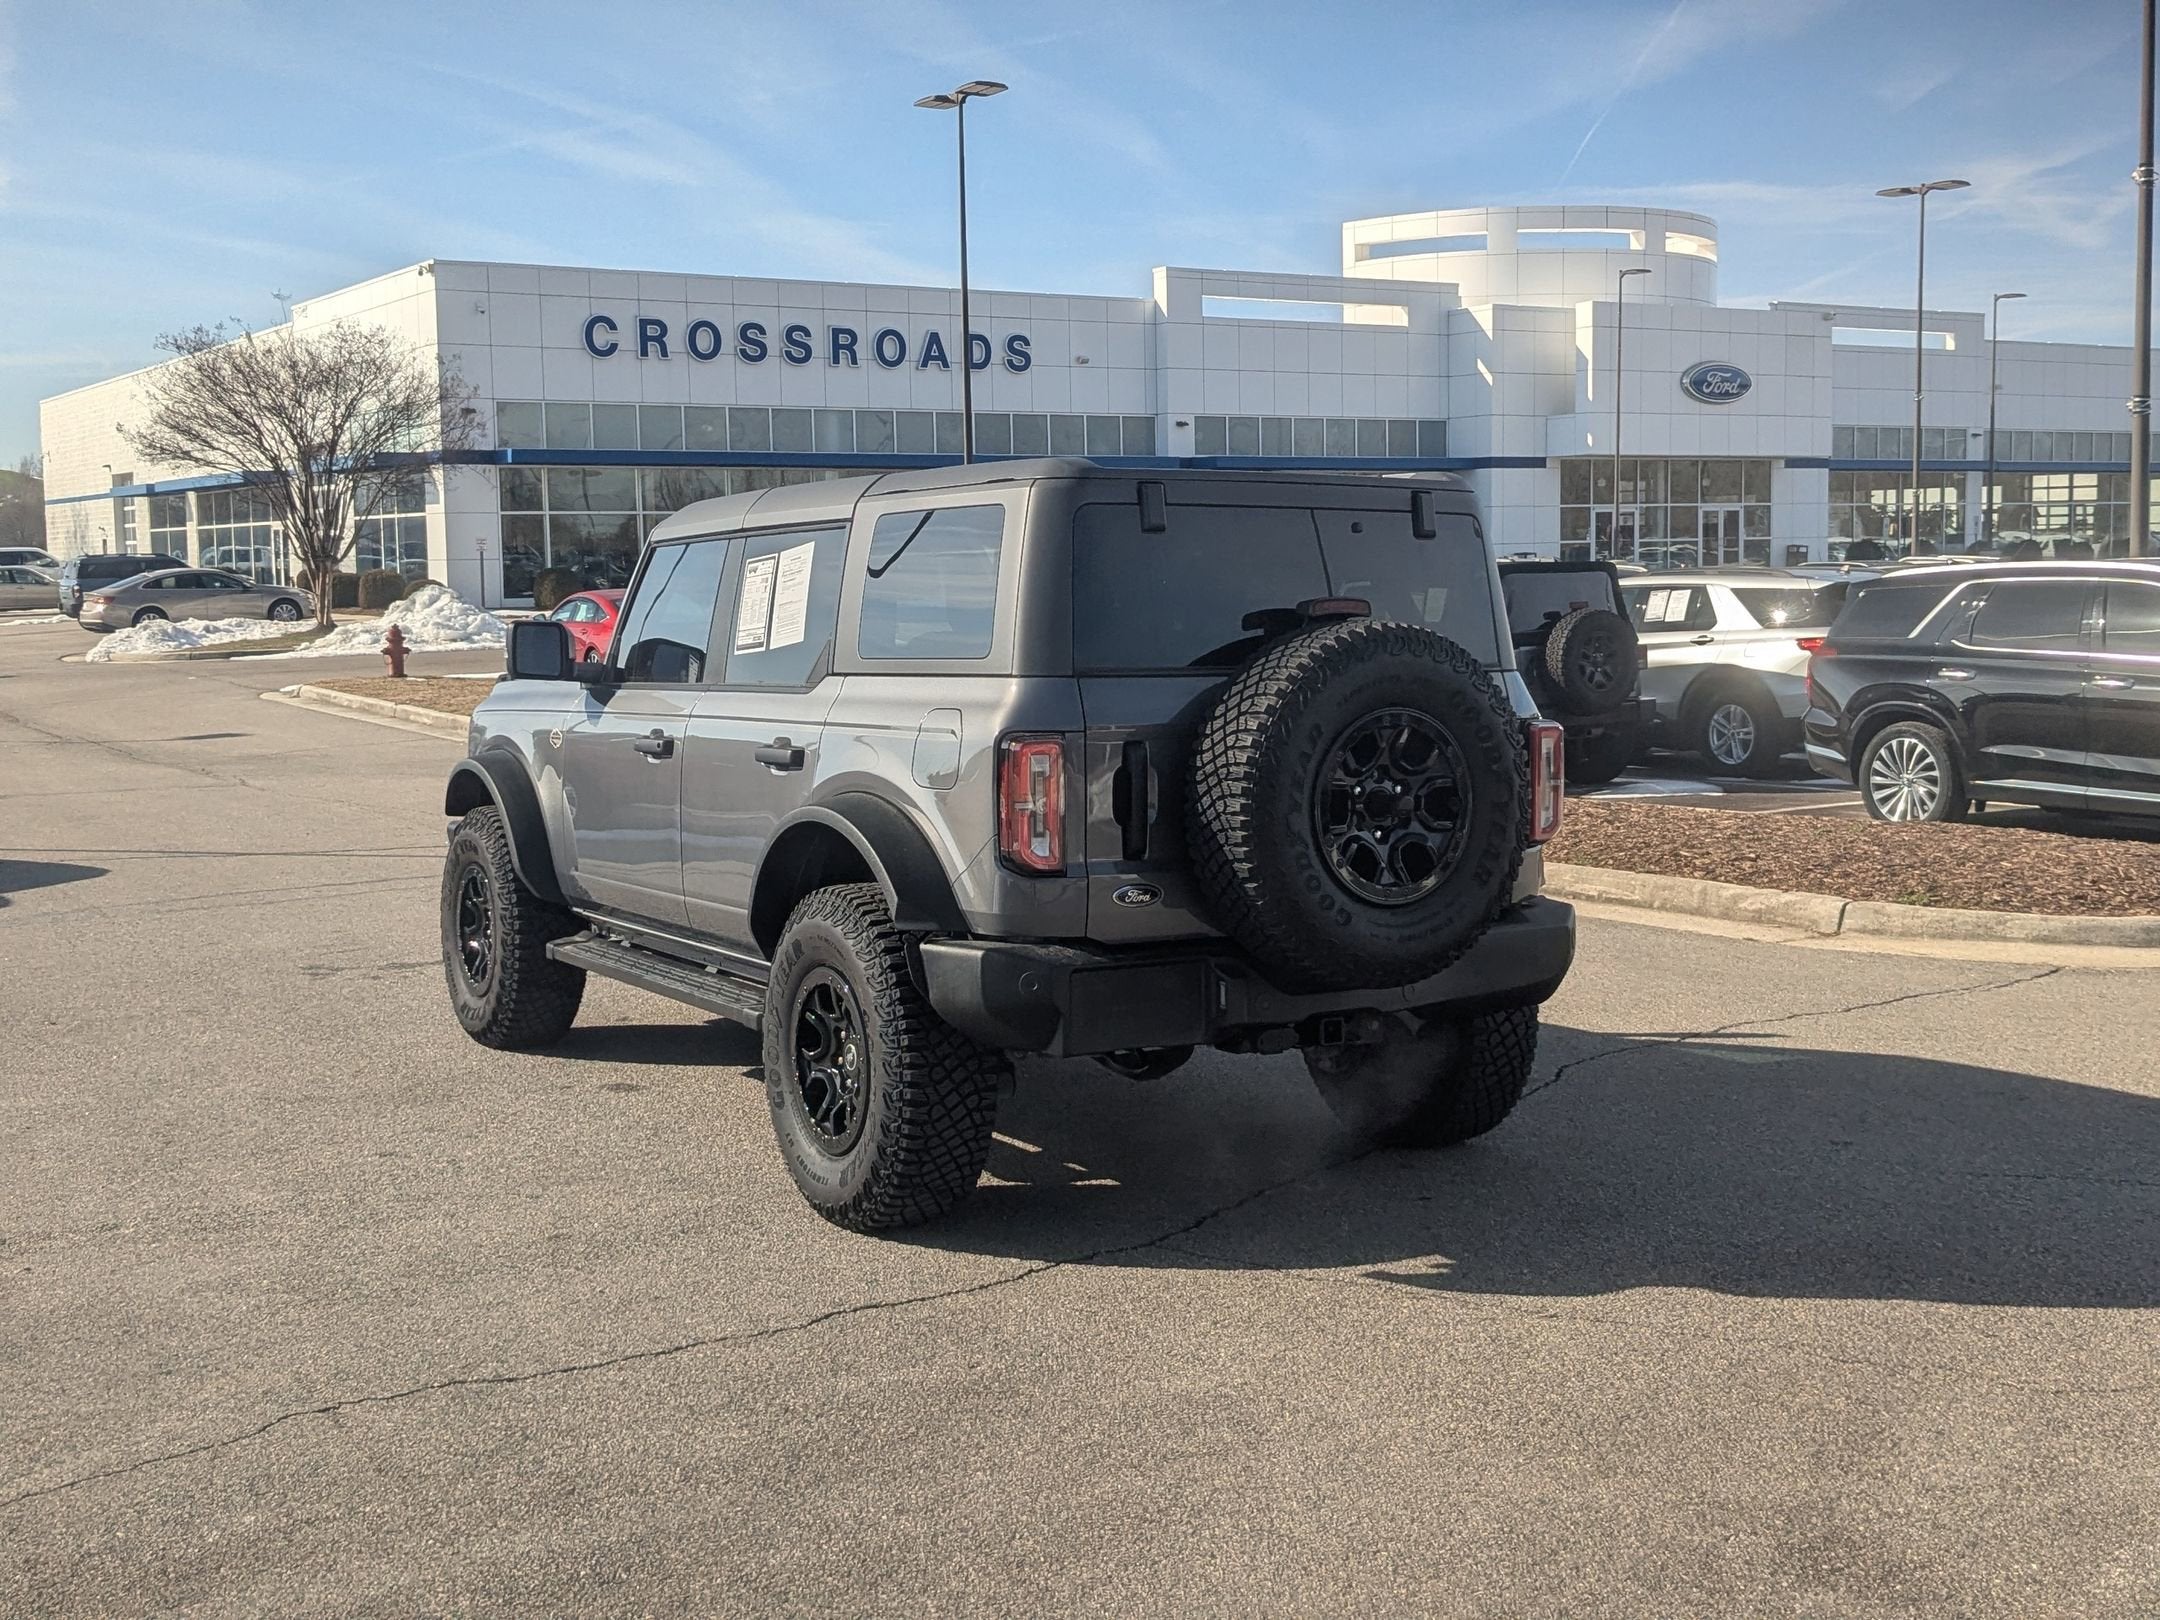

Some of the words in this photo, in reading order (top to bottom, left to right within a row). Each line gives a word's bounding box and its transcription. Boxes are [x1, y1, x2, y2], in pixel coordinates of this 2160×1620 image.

[583, 315, 1033, 374] CROSSROADS
[1702, 371, 1740, 394] Ford
[1125, 889, 1151, 902] Ford
[767, 938, 805, 1111] GOODYEAR
